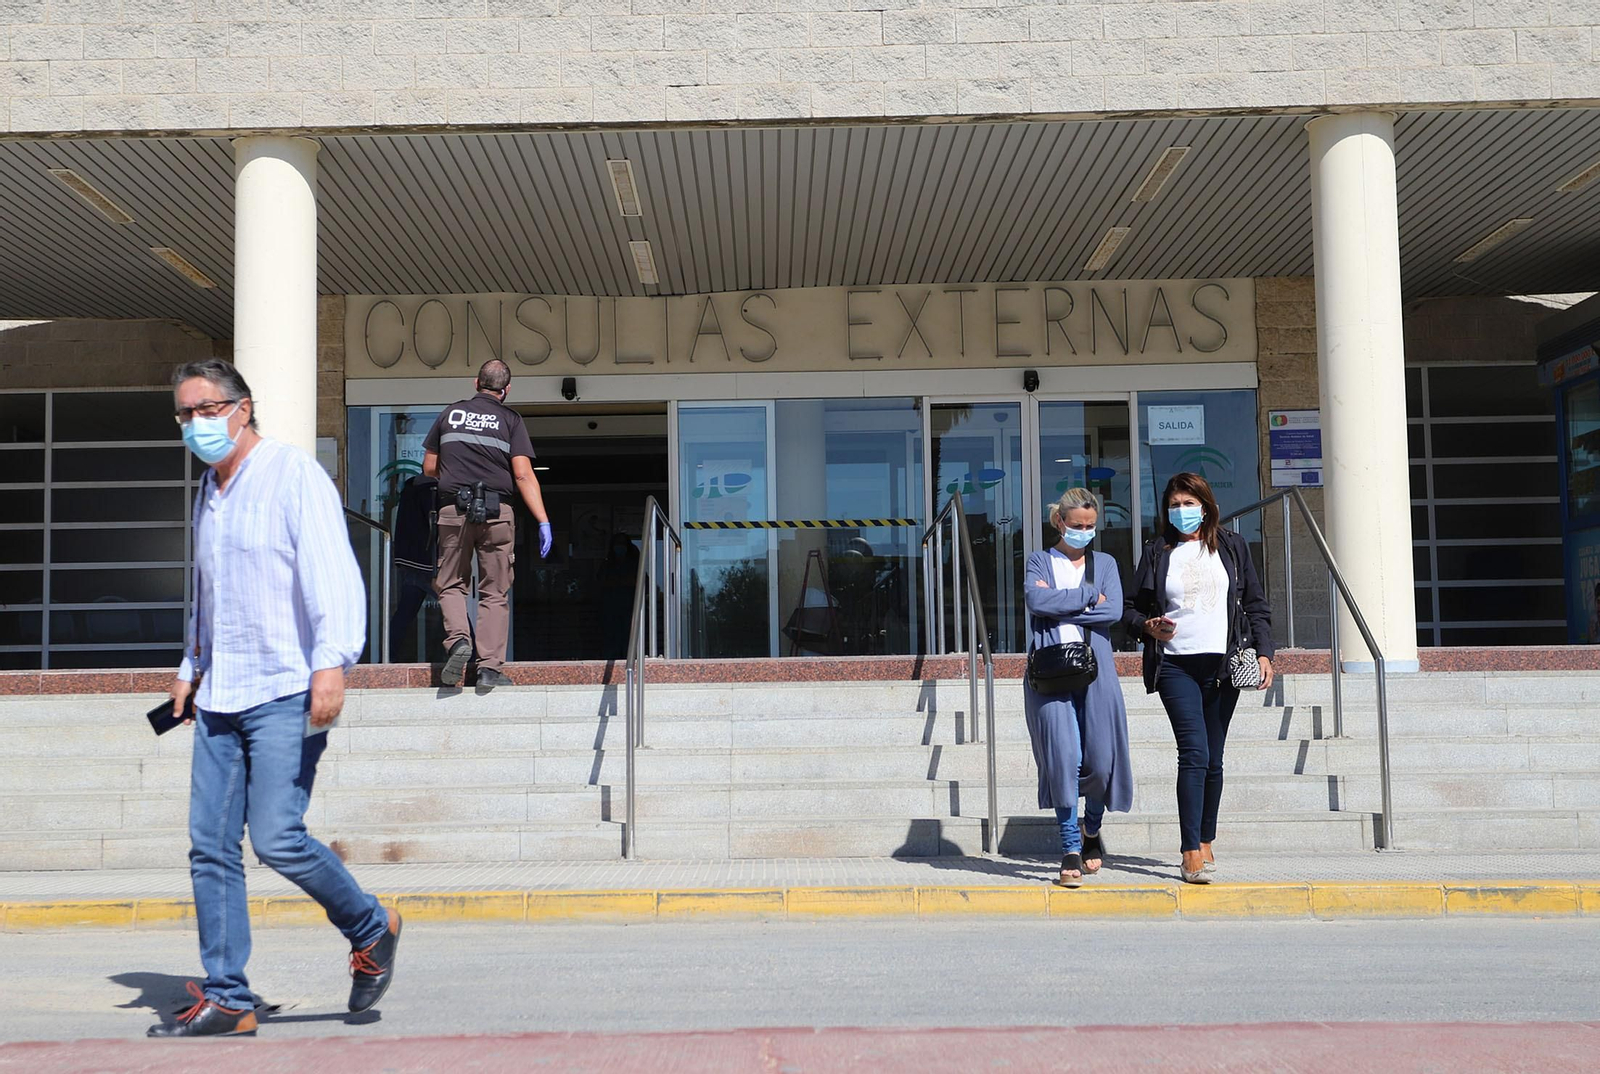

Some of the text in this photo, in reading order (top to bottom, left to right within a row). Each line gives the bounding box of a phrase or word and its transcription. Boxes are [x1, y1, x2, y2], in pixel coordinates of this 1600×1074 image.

[365, 283, 1230, 369] CONSULTAS EXTERNAS
[466, 412, 497, 421] grupo
[465, 419, 500, 430] control
[1158, 421, 1194, 430] SALIDA
[401, 449, 426, 458] ENTR
